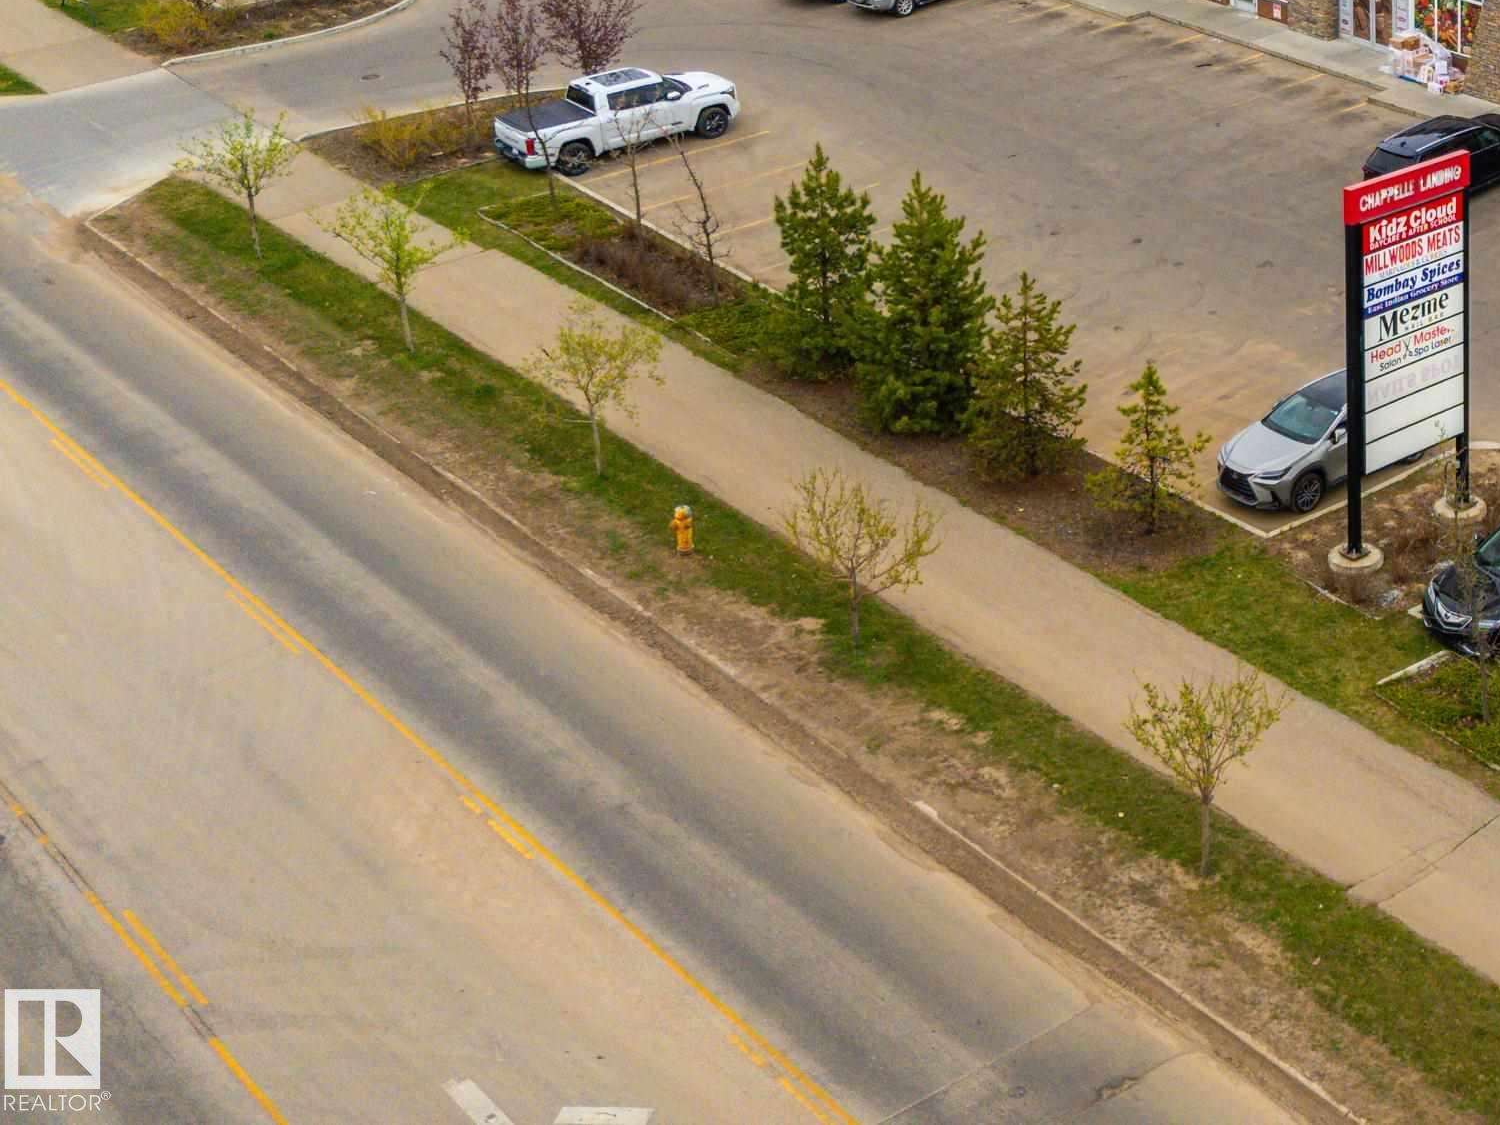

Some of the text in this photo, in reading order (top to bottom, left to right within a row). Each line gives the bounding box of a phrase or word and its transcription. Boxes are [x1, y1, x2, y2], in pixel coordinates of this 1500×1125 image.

[1359, 165, 1462, 212] CHAPPELLE LANDING
[1369, 232, 1400, 250] DAYCARE
[1408, 223, 1429, 237] AFTER
[1430, 213, 1457, 229] SCHOOL
[1409, 196, 1457, 228] Cloud
[1364, 238, 1424, 275] MILLWOODS
[1427, 225, 1461, 247] MEATS
[1366, 274, 1418, 303] Bombay
[1420, 259, 1461, 283] Spices
[1367, 275, 1460, 314] East Indian Grocery Store
[1377, 292, 1449, 343] Mezme
[1370, 325, 1455, 364] Head Maste
[1379, 357, 1402, 372] Salon
[1414, 346, 1430, 358] Spa
